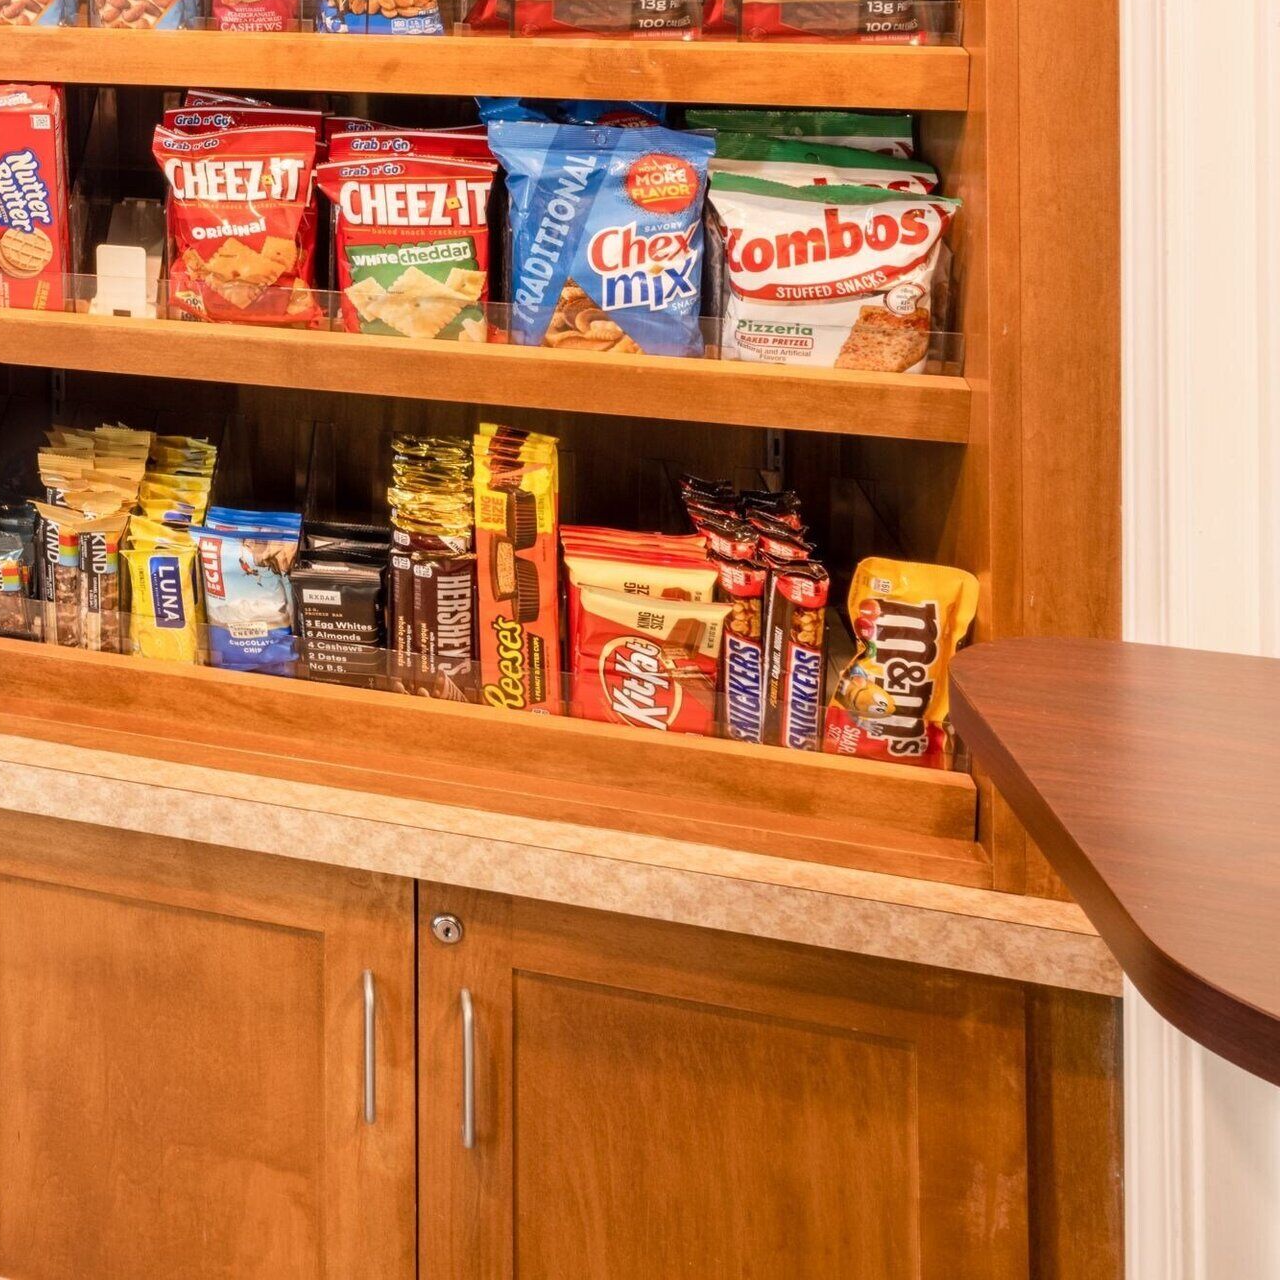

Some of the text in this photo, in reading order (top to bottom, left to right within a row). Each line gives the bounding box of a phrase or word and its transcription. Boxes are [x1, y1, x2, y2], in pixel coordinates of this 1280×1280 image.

[220, 21, 283, 32] CASHEWS
[174, 115, 200, 125] Grab
[203, 138, 218, 148] Go
[636, 169, 687, 186] MORE
[6, 151, 50, 224] Nutter
[632, 184, 690, 199] FLAVOR
[644, 222, 683, 233] SAVORY
[513, 156, 597, 323] TRADITIONAL
[591, 224, 696, 271] Chex
[399, 241, 470, 264] cheddar
[606, 258, 692, 308] mix
[776, 270, 888, 299] STUFFED SNACKS
[737, 320, 813, 336] Pizzeria
[772, 337, 809, 347] PRETZEL
[92, 532, 107, 573] KIND
[202, 540, 219, 583] CLIF
[158, 566, 180, 621] LUNA
[314, 620, 372, 631] Egg Whites
[437, 575, 471, 676] HERSHEY'S
[637, 611, 651, 629] KING
[651, 614, 665, 631] SIZE
[315, 631, 361, 641] Almonds
[317, 642, 362, 652] Cashews
[318, 653, 347, 662] Dates
[728, 639, 761, 745] SNICKERS
[790, 650, 821, 752] SNICKERS
